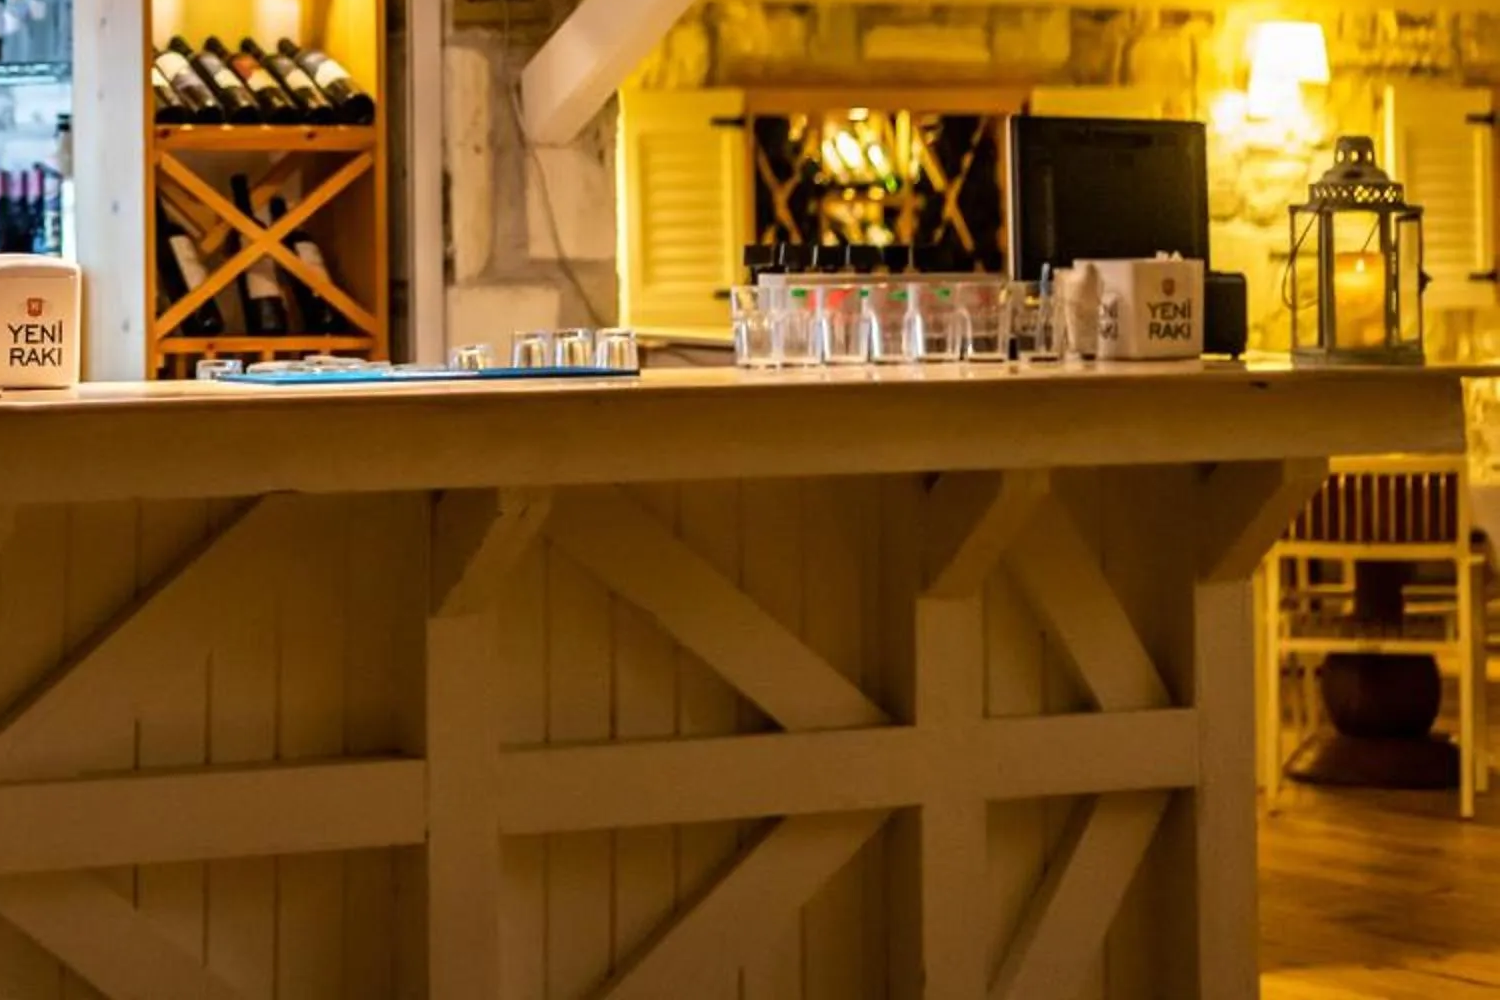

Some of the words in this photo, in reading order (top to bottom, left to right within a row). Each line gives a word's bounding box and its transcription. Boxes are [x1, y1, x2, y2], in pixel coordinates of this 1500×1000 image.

[1146, 298, 1192, 321] YENİ
[7, 320, 63, 345] YENİ
[1149, 322, 1192, 340] RAKI
[9, 347, 63, 367] RAKI
